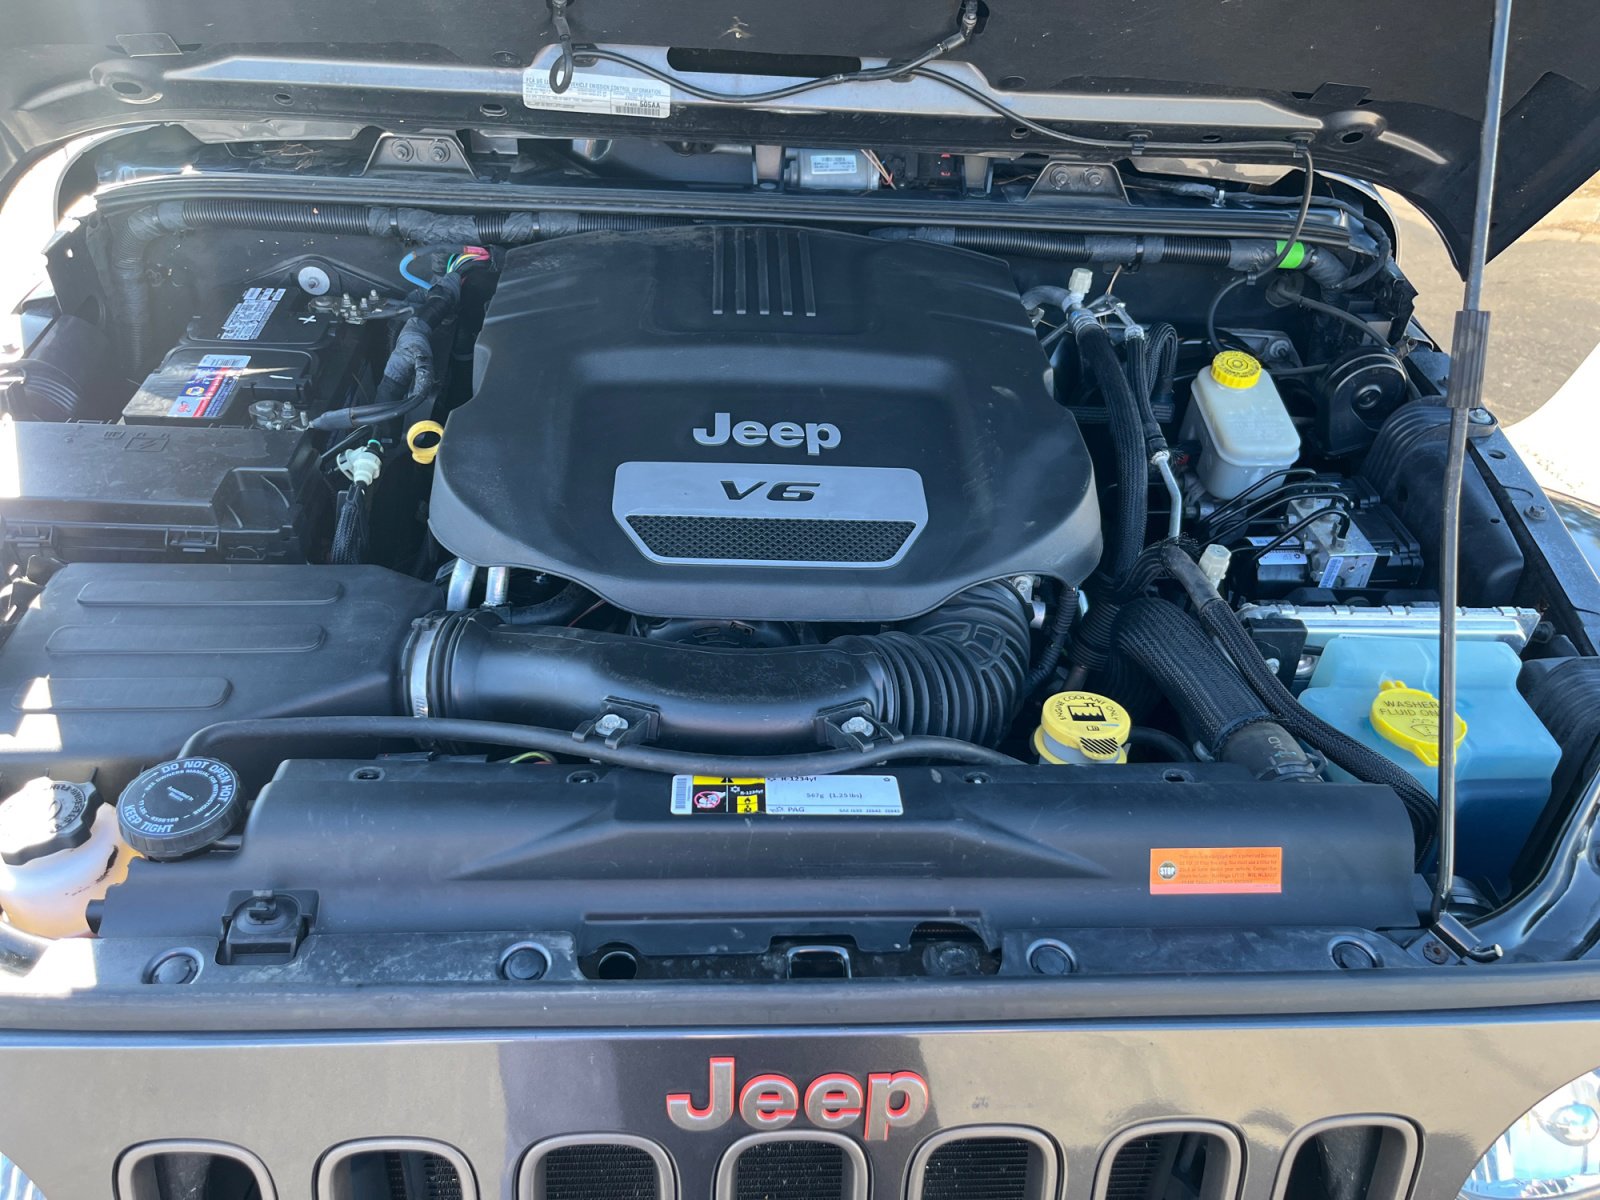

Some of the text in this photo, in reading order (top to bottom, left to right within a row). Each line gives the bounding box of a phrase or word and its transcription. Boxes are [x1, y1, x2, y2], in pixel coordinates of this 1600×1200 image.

[693, 412, 842, 456] Jeep
[720, 480, 821, 502] V6
[1063, 694, 1108, 705] COOLANT
[1105, 705, 1119, 721] ONLY
[1379, 708, 1417, 716] FLUID
[1383, 700, 1440, 709] WASHER
[161, 760, 233, 803] DO NOT OPEN HOT
[124, 804, 174, 833] KEEP TIGHT
[1159, 866, 1176, 876] STOP
[666, 1056, 929, 1142] Jeep
